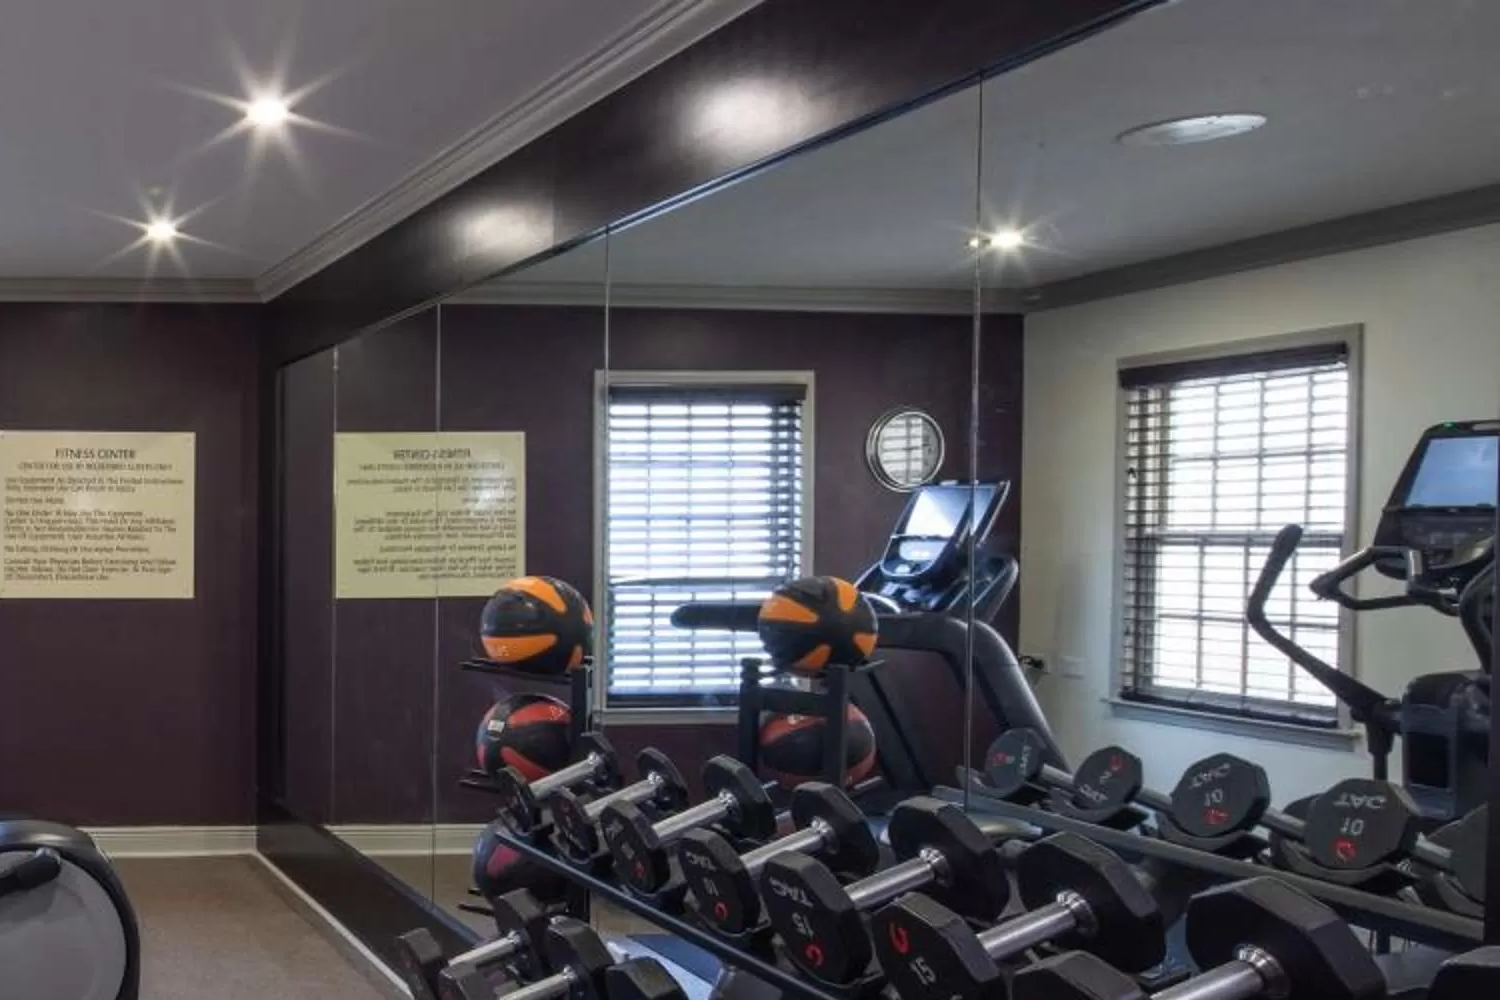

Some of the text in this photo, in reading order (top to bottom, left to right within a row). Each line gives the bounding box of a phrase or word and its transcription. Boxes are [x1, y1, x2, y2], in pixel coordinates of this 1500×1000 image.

[55, 448, 136, 459] FITNESS CENTER
[909, 956, 937, 986] 15
